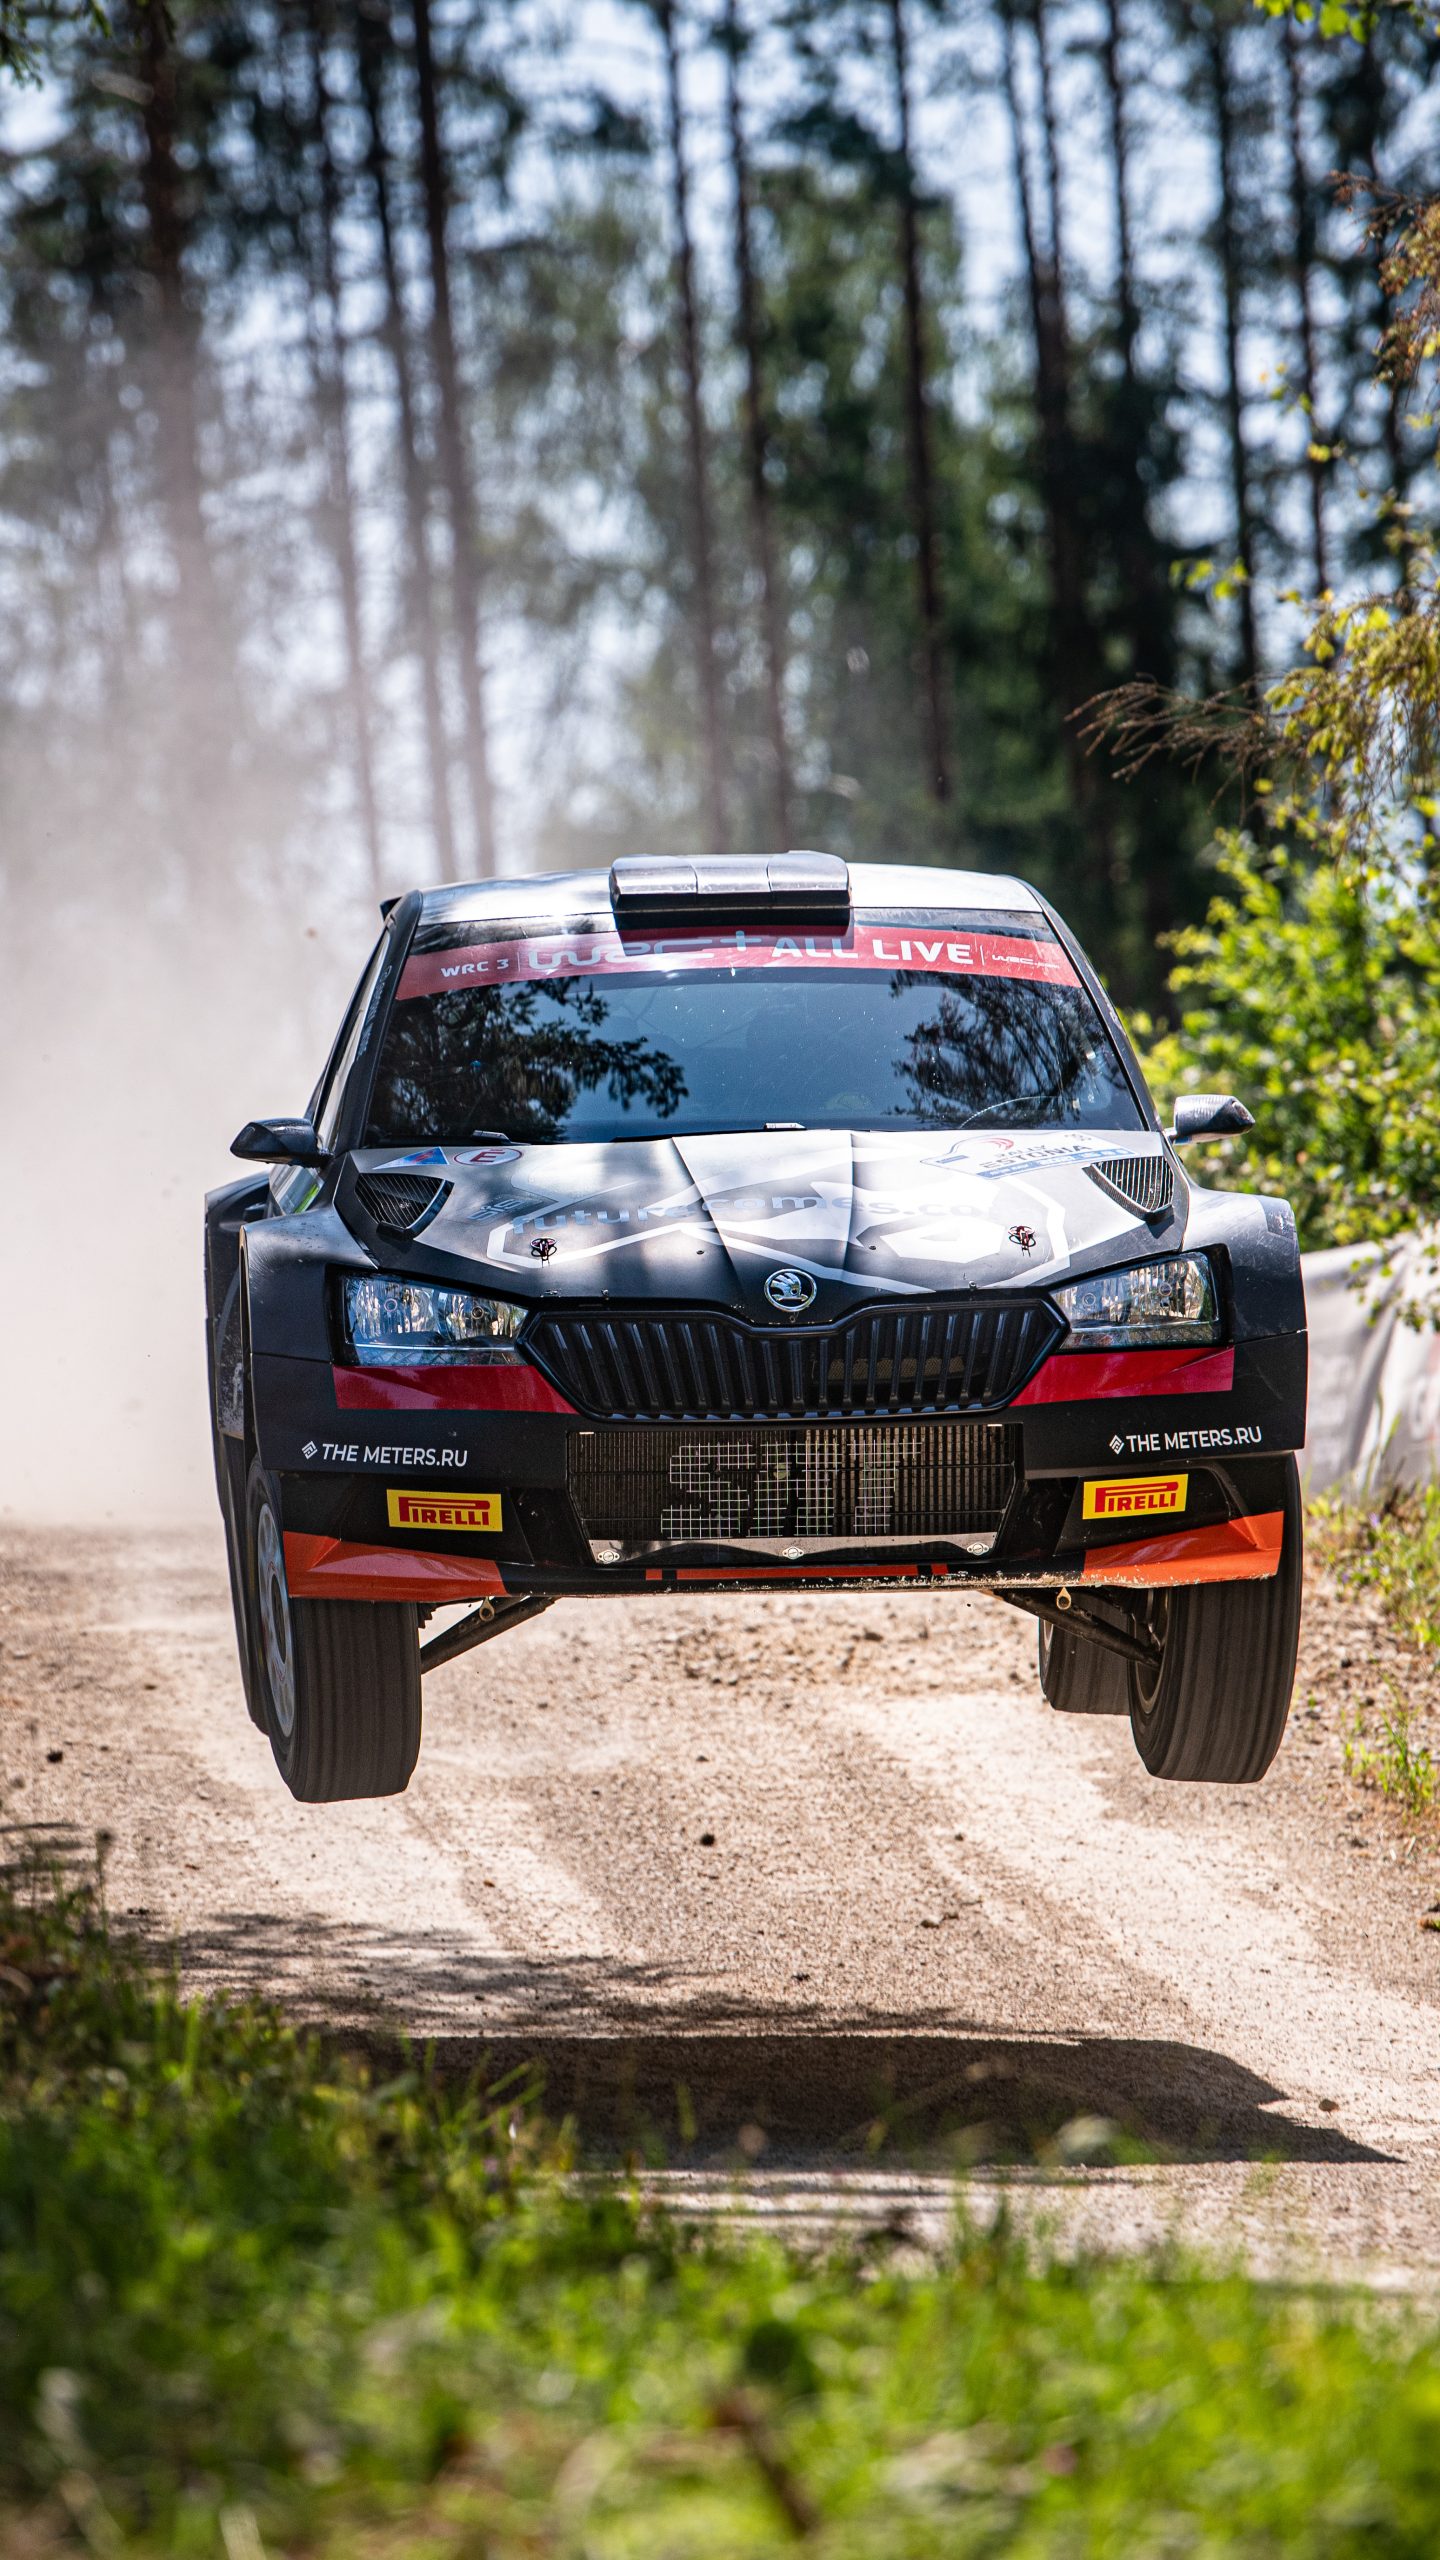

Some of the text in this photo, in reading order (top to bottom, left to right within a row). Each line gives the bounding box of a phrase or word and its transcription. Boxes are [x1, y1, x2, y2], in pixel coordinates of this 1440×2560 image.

[440, 961, 489, 977] WRC
[496, 958, 509, 969] 3
[771, 937, 859, 959] ALL
[872, 939, 974, 965] LIVE
[978, 1144, 1093, 1169] ESTONIA
[1126, 1425, 1262, 1453] THE METERS.RU
[322, 1443, 468, 1468] THE METERS.RU
[398, 1496, 491, 1526] PIRELLI
[1094, 1481, 1179, 1513] PIRELLI
